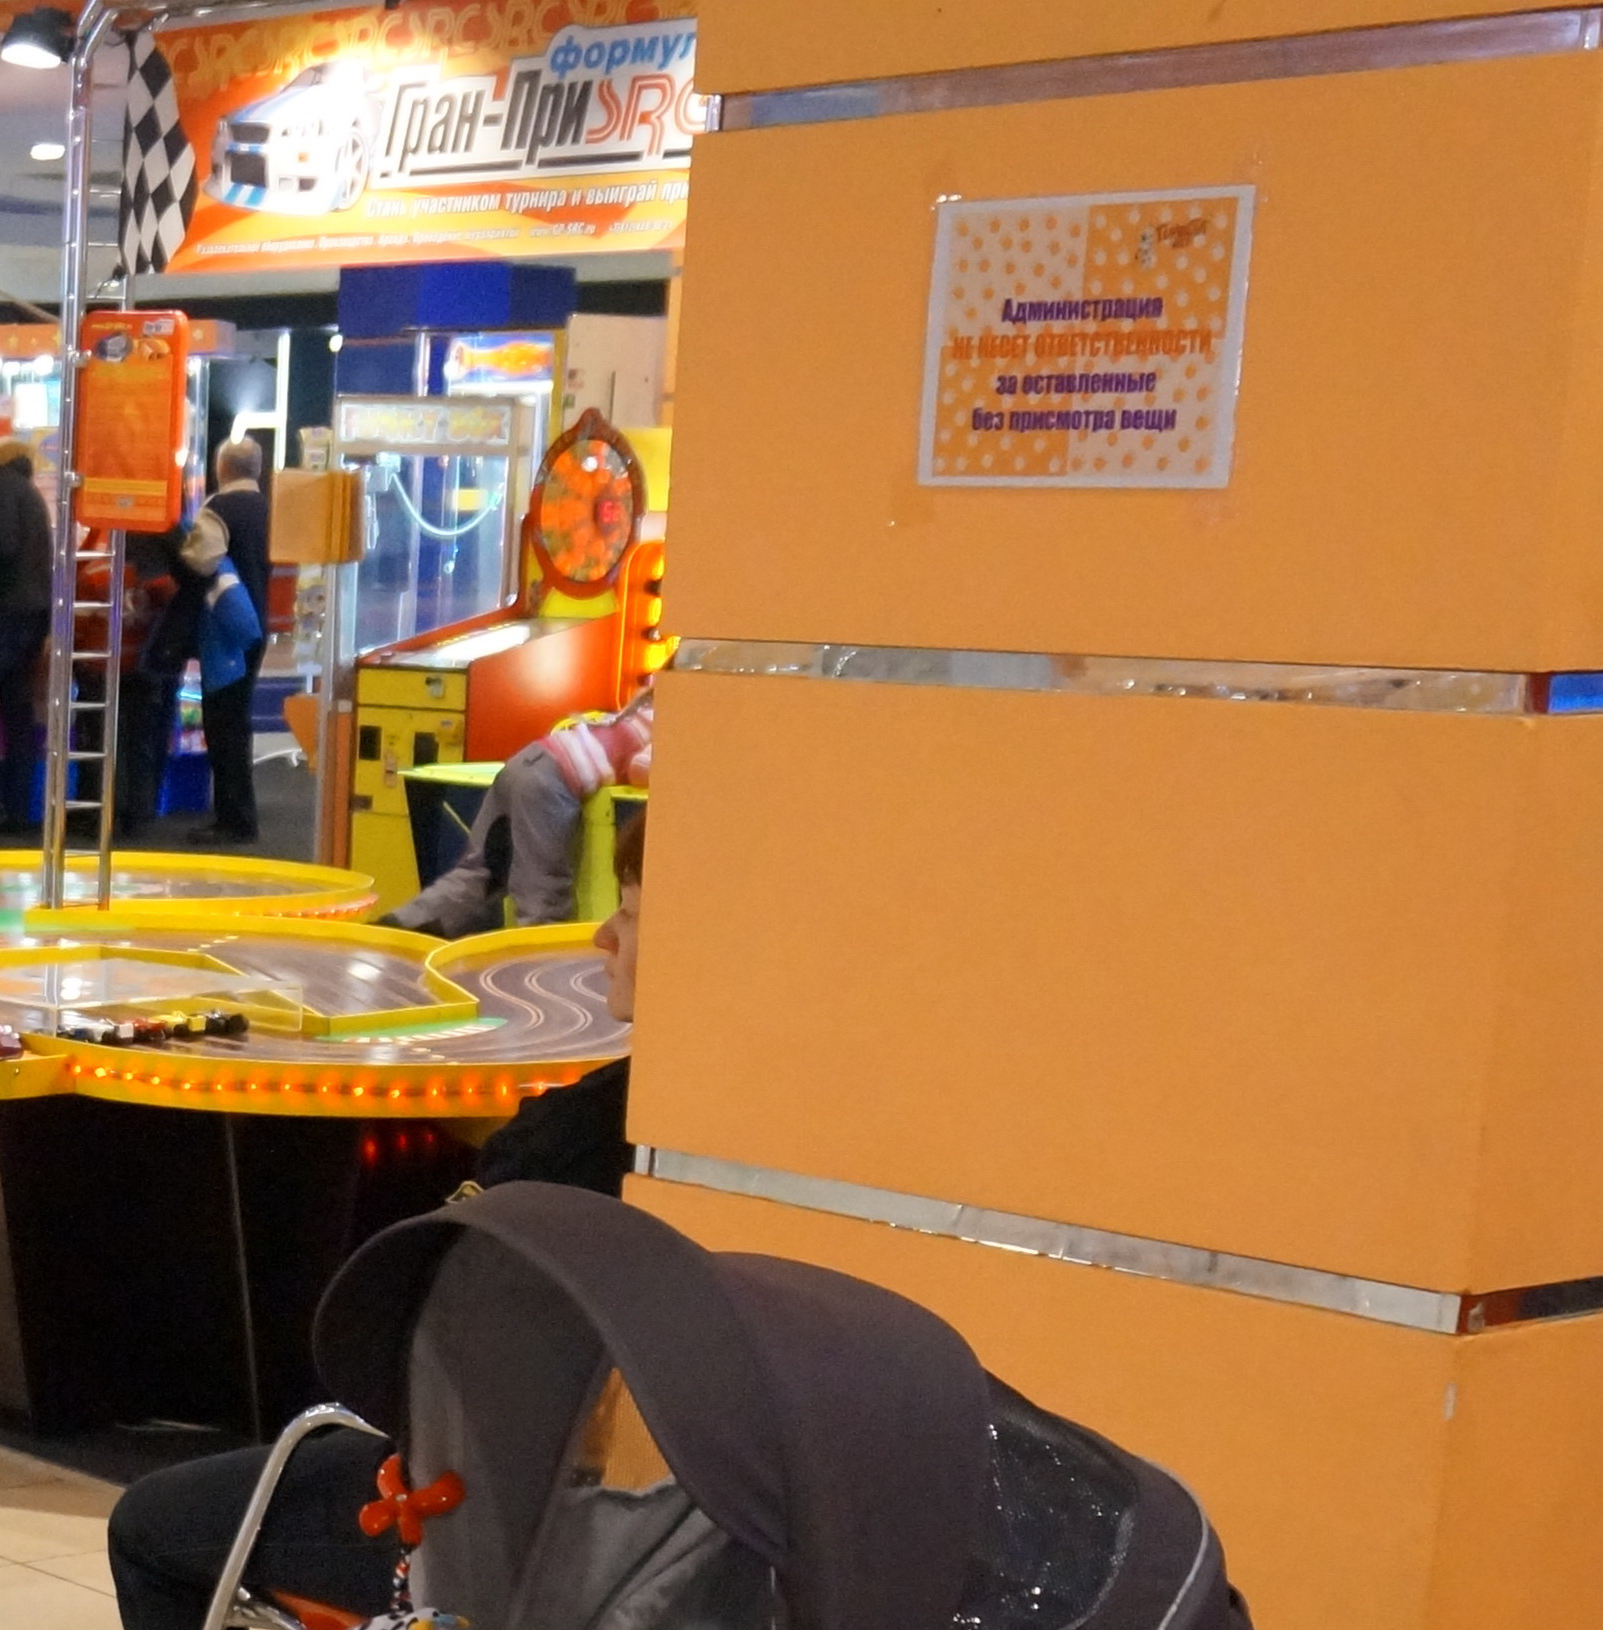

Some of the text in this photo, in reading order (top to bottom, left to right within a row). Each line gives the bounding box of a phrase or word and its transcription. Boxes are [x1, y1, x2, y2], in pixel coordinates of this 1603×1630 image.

[384, 69, 594, 173] Гран-При
[411, 193, 501, 219] участником
[505, 188, 567, 214] турнира
[571, 187, 582, 206] и
[586, 180, 658, 209] выиграй
[1002, 297, 1163, 324] Администрация
[996, 372, 1157, 395] за оставленные
[971, 407, 1177, 433] без присмотра вещи
